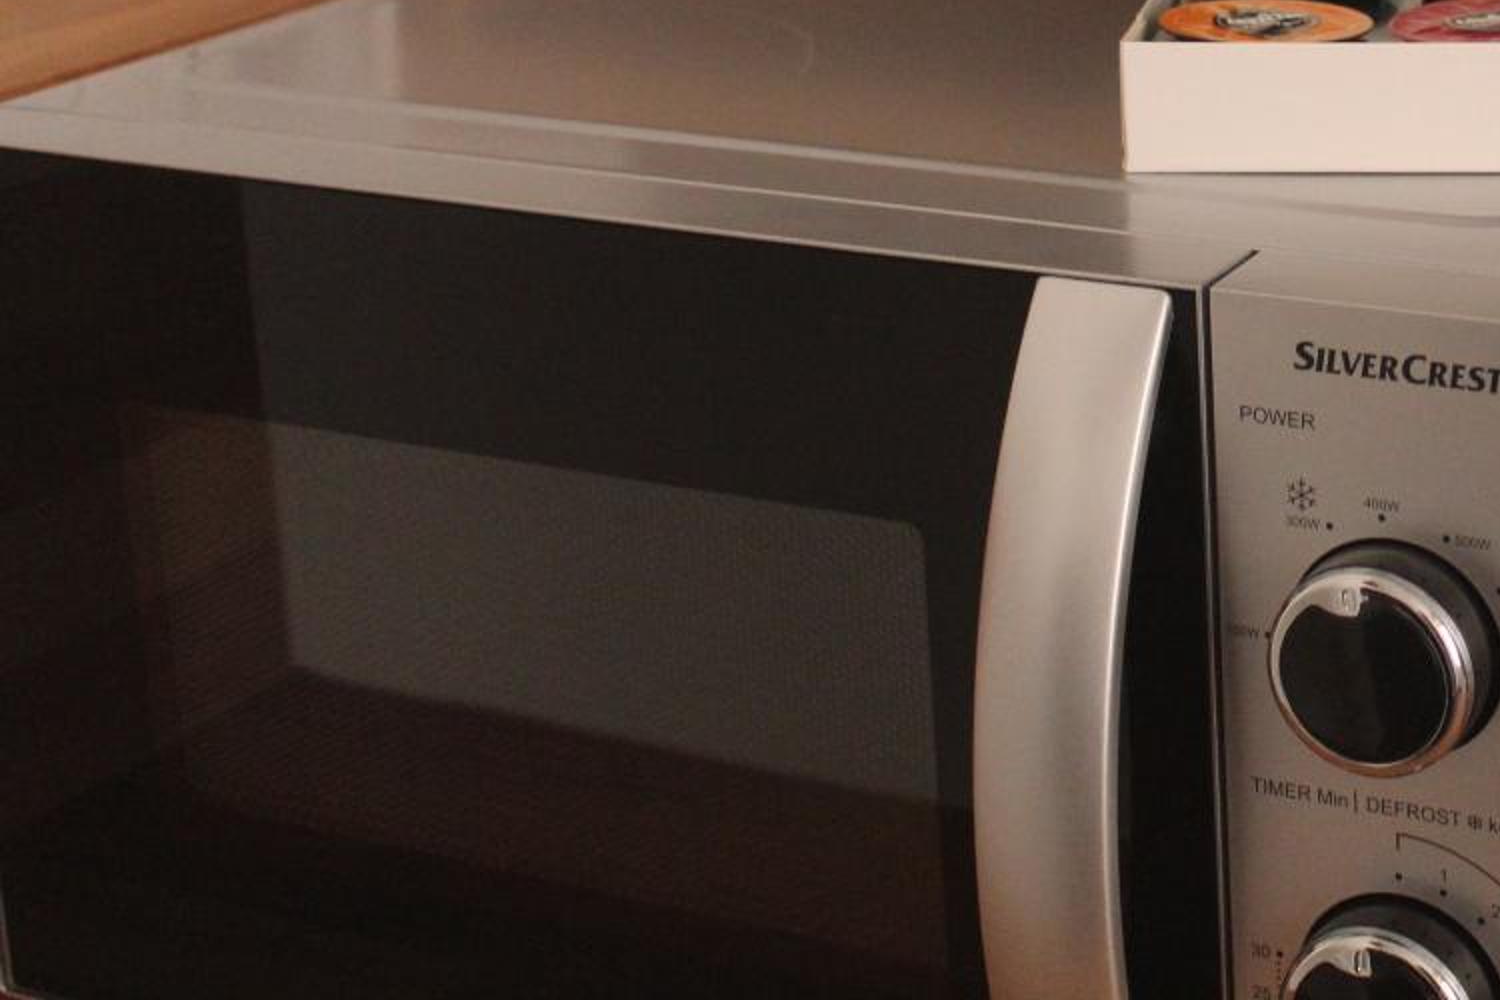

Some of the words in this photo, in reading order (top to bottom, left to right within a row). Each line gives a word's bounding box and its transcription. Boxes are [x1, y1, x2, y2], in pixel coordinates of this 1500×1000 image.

[1239, 404, 1316, 431] POWER
[1363, 496, 1400, 512] 400W
[1454, 533, 1492, 552] 500W
[1252, 776, 1311, 802] TIMER
[1317, 786, 1349, 809] Min
[1365, 799, 1461, 827] DEFROST
